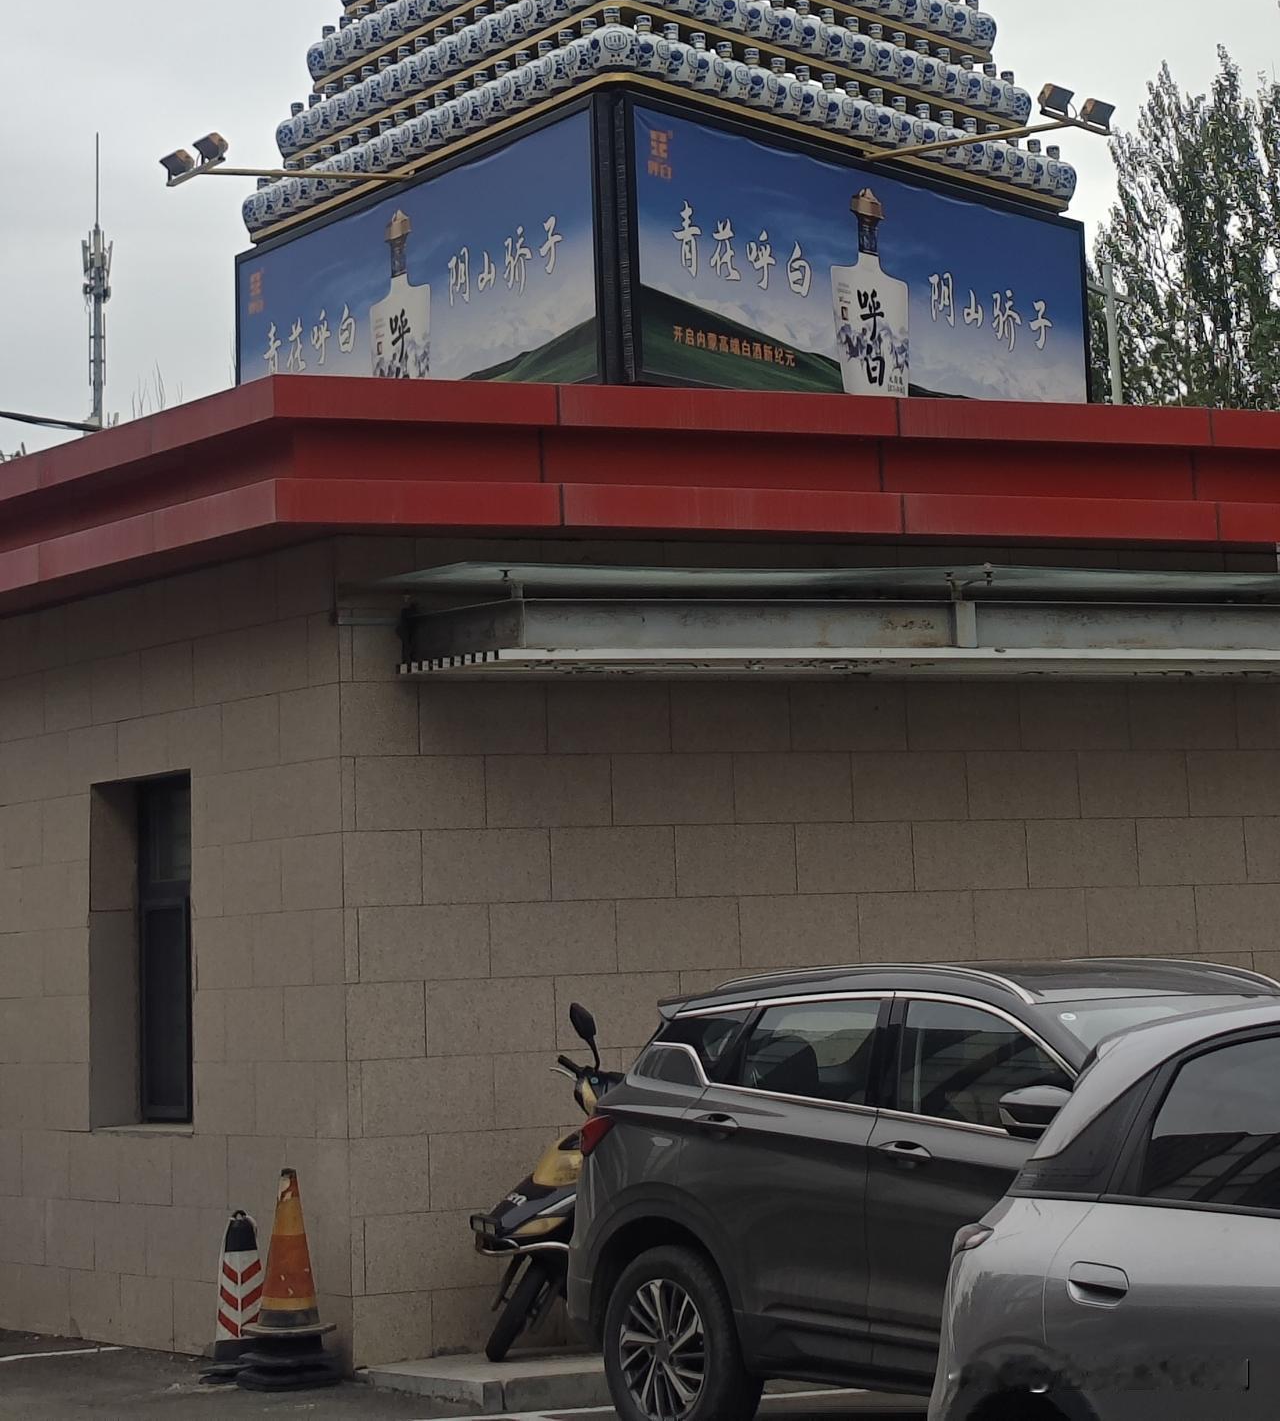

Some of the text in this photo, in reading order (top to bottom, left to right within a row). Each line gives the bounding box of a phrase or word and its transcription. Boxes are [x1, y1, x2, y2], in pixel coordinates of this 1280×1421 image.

[447, 215, 563, 306] 阴山骄子
[672, 200, 812, 297] 青花呼白
[263, 303, 356, 374] 青花呼白
[389, 308, 411, 378] 呼
[673, 325, 796, 367] 开启内蒙高端白酒新纪元
[857, 288, 885, 386] 呼白
[927, 272, 1054, 351] 阴山骄子
